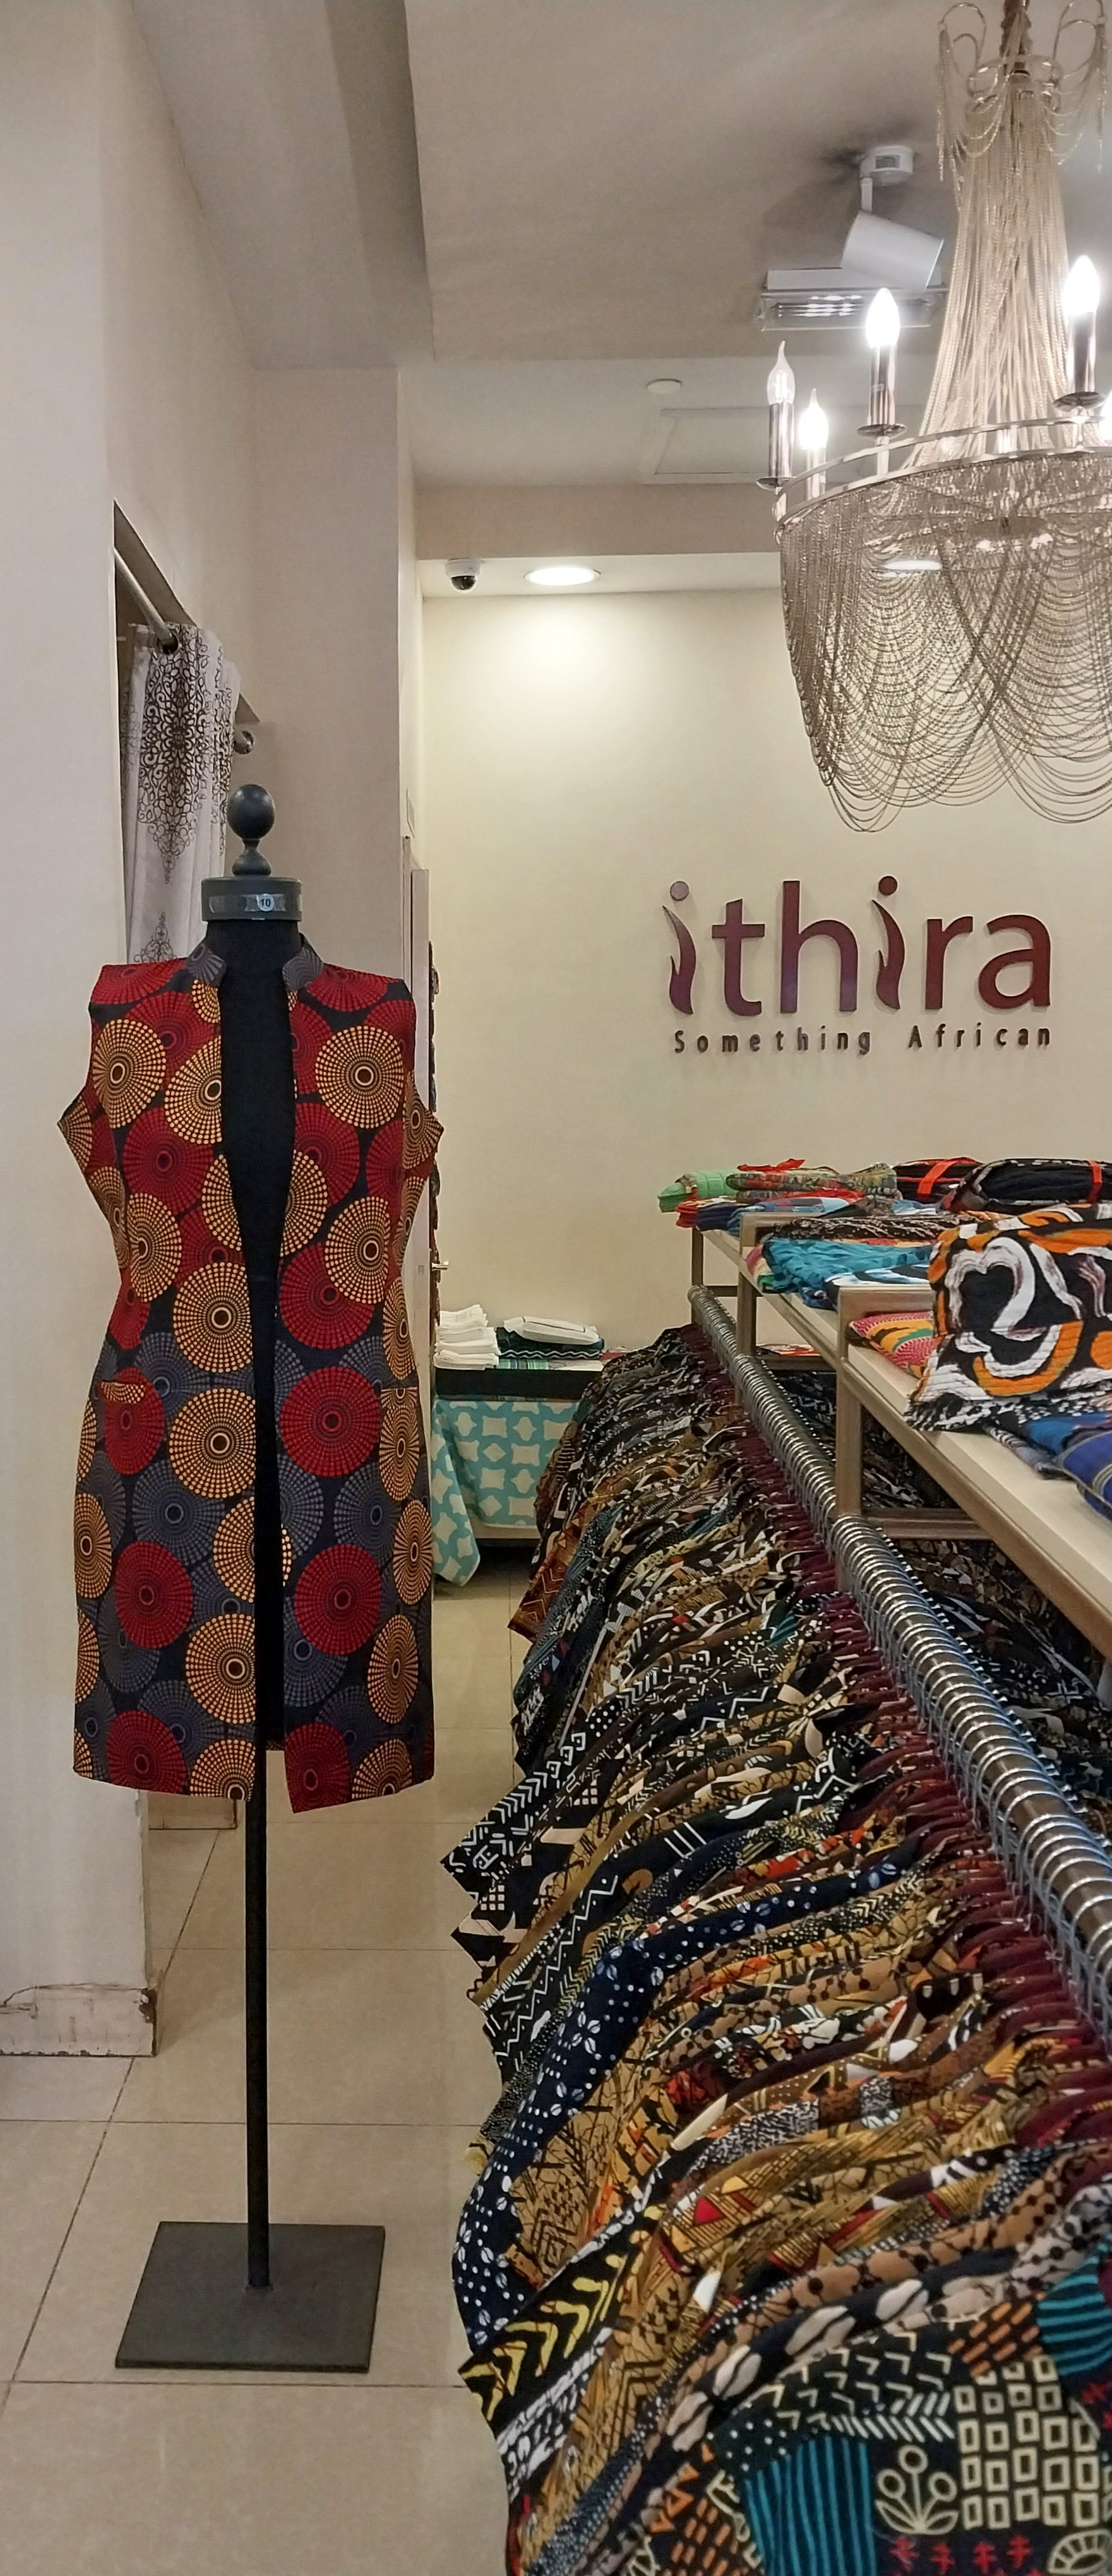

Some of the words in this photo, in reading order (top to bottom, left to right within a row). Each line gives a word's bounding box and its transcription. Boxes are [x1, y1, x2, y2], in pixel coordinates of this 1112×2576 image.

[260, 898, 272, 907] 10
[662, 875, 1051, 1017] ithira
[674, 1025, 871, 1055] Something
[907, 1023, 1051, 1050] African
